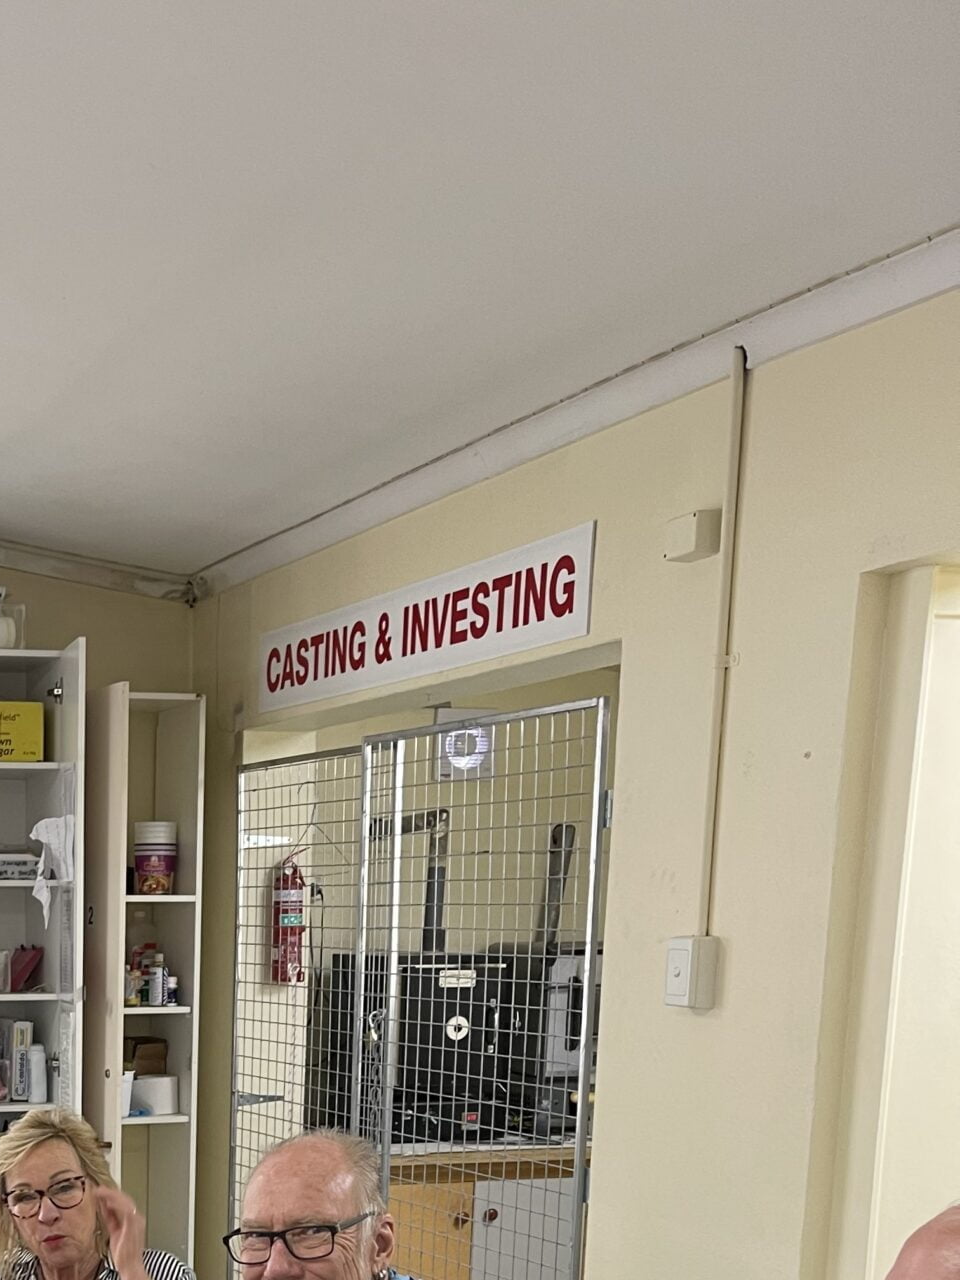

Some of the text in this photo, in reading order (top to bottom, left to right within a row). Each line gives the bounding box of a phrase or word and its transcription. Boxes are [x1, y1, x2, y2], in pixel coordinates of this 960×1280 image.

[267, 554, 576, 693] CASTING & INVESTING
[88, 907, 94, 925] 2
